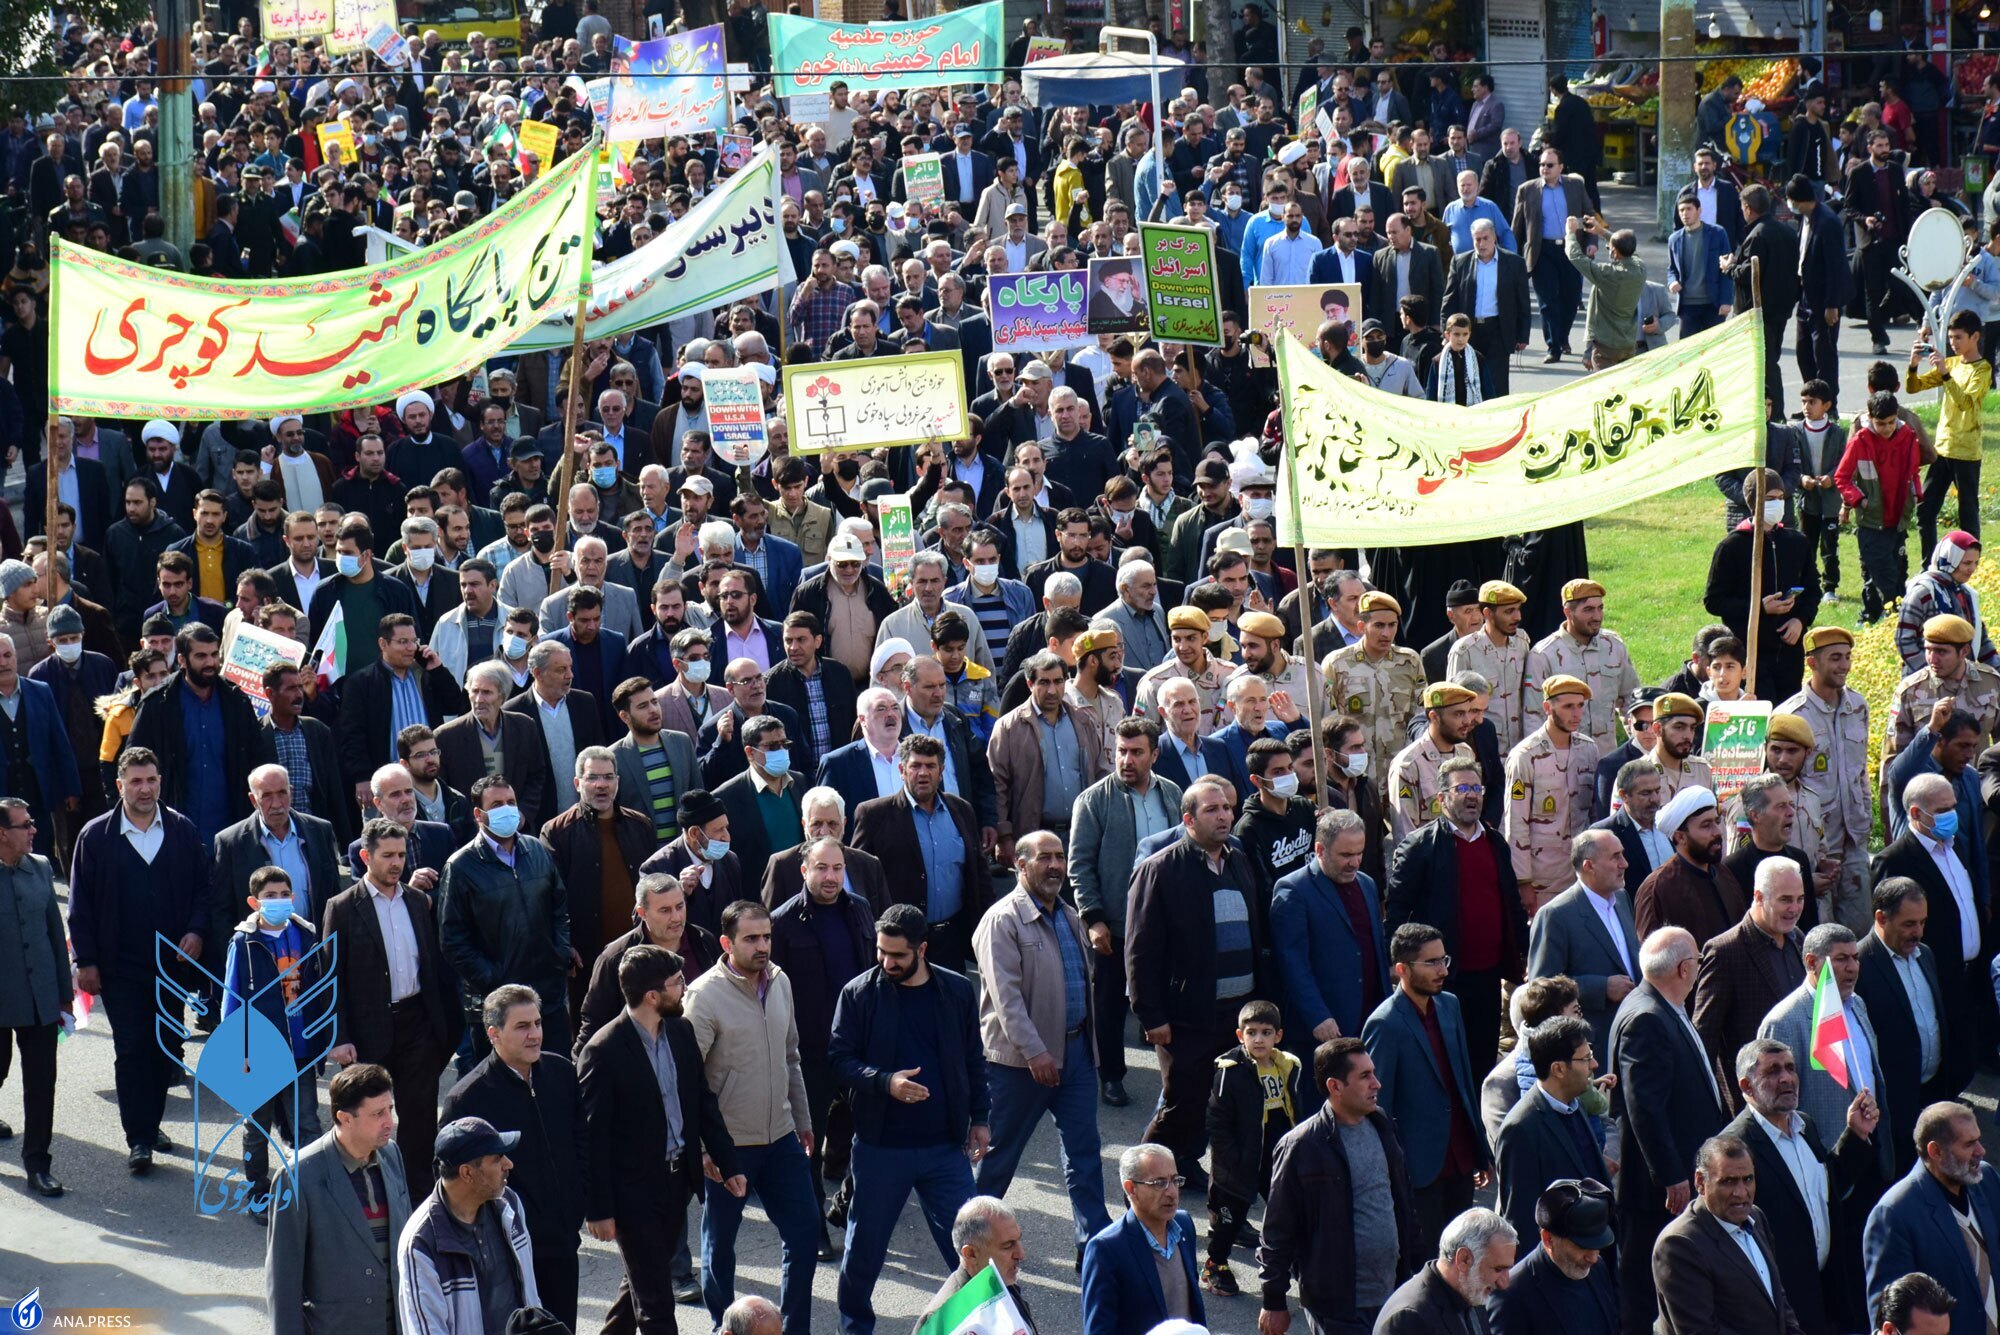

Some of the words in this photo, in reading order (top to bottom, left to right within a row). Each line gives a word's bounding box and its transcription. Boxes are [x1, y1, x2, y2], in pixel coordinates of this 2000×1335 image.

[828, 28, 887, 50] علمیه
[889, 24, 943, 48] حوزه
[793, 52, 841, 87] خوی
[860, 45, 934, 81] خمینی
[936, 41, 981, 76] امام
[685, 75, 725, 125] شهید
[1155, 238, 1168, 253] بر
[1172, 236, 1200, 255] مرگ
[1151, 256, 1208, 281] اسرائیل
[415, 242, 522, 346] پایگاه
[997, 271, 1085, 315] پایگاه
[1151, 281, 1184, 293] Down
[1185, 284, 1211, 296] with
[1156, 291, 1209, 310] Israel
[1267, 303, 1290, 316] آمریکا
[231, 280, 420, 391] شهید
[994, 316, 1033, 345] نظری
[1033, 320, 1059, 342] سید
[1060, 313, 1088, 341] شهید
[860, 374, 890, 395] آموزی
[889, 365, 912, 393] دانش
[911, 368, 928, 397] بسیج
[928, 373, 945, 393] حوزه
[709, 406, 736, 414] DOWN
[736, 404, 759, 413] WITH
[856, 401, 879, 424] خوی
[934, 401, 955, 428] شهید
[712, 425, 739, 433] DOWN
[739, 423, 762, 432] WITH
[877, 410, 895, 431] سپاه
[723, 432, 752, 440] ISRAEL
[1520, 392, 1646, 484] مقاومت
[888, 509, 901, 529] آخر
[900, 510, 907, 525] تا
[226, 664, 257, 682] DOWN
[250, 697, 272, 711] WIT
[1718, 718, 1748, 742] آخر
[1746, 719, 1757, 737] تا
[1717, 767, 1747, 776] STAND
[1747, 767, 1761, 775] UP
[1717, 780, 1734, 789] THE
